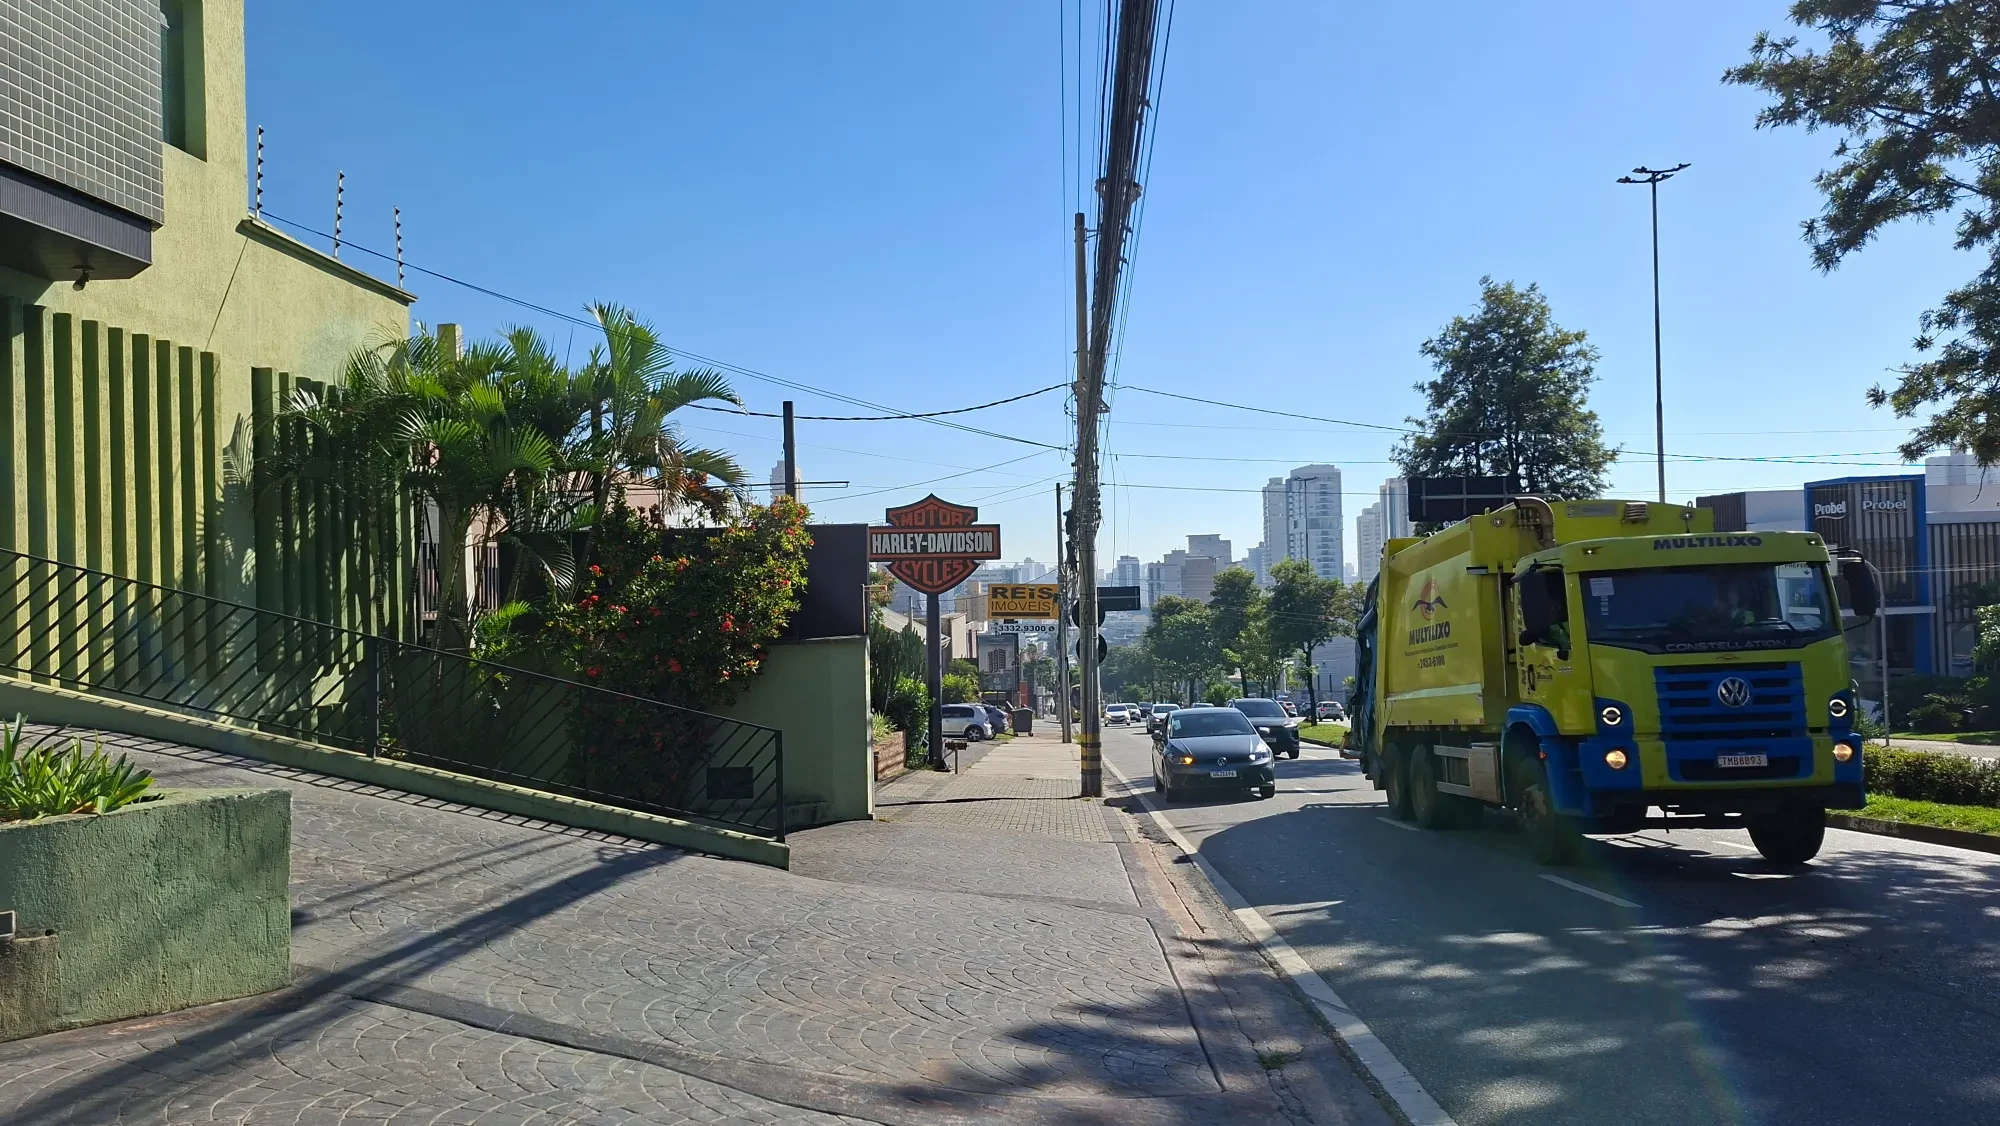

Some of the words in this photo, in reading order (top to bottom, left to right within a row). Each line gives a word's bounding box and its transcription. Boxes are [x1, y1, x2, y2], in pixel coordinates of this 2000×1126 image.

[1814, 501, 1847, 516] Probel
[1862, 500, 1906, 510] Probel
[901, 504, 963, 526] MOTOR
[872, 531, 993, 554] HARLEY-DAVIDSON
[1653, 536, 1763, 550] MULTILIXO
[901, 561, 963, 586] CYCLES
[991, 599, 1051, 611] IMÓVEIS
[1408, 621, 1451, 646] MULTILIXO
[1666, 639, 1786, 650] CONSTELLATION
